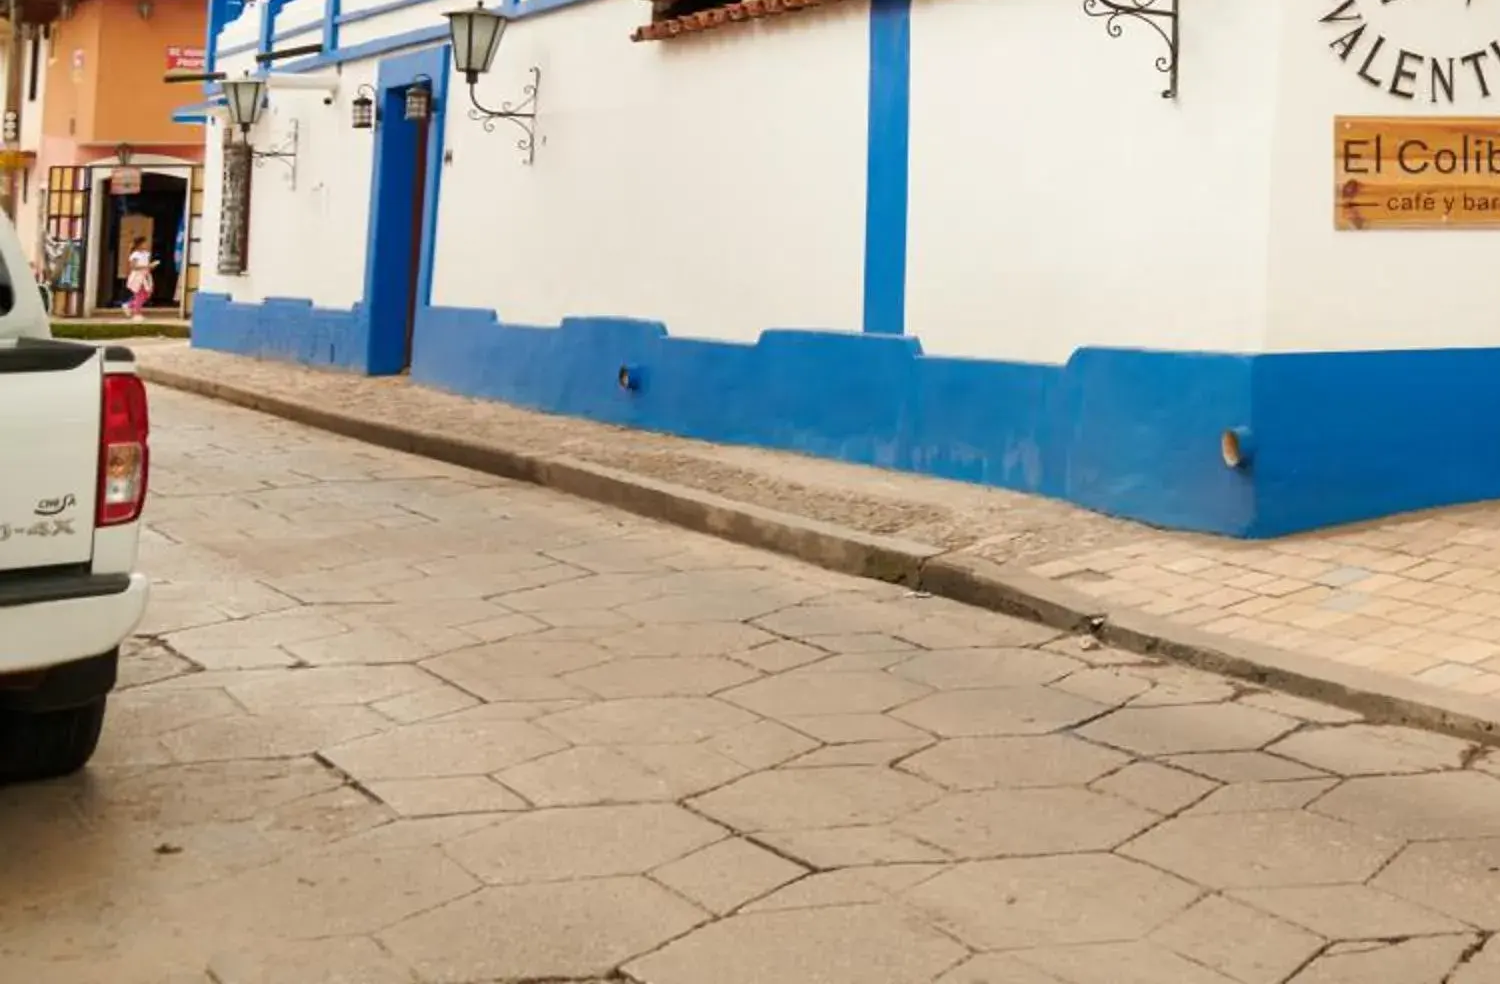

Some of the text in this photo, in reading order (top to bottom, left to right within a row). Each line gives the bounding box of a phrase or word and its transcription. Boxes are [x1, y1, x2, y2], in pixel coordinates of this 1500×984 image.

[1343, 134, 1381, 174] El
[1386, 192, 1500, 215] café y bar
